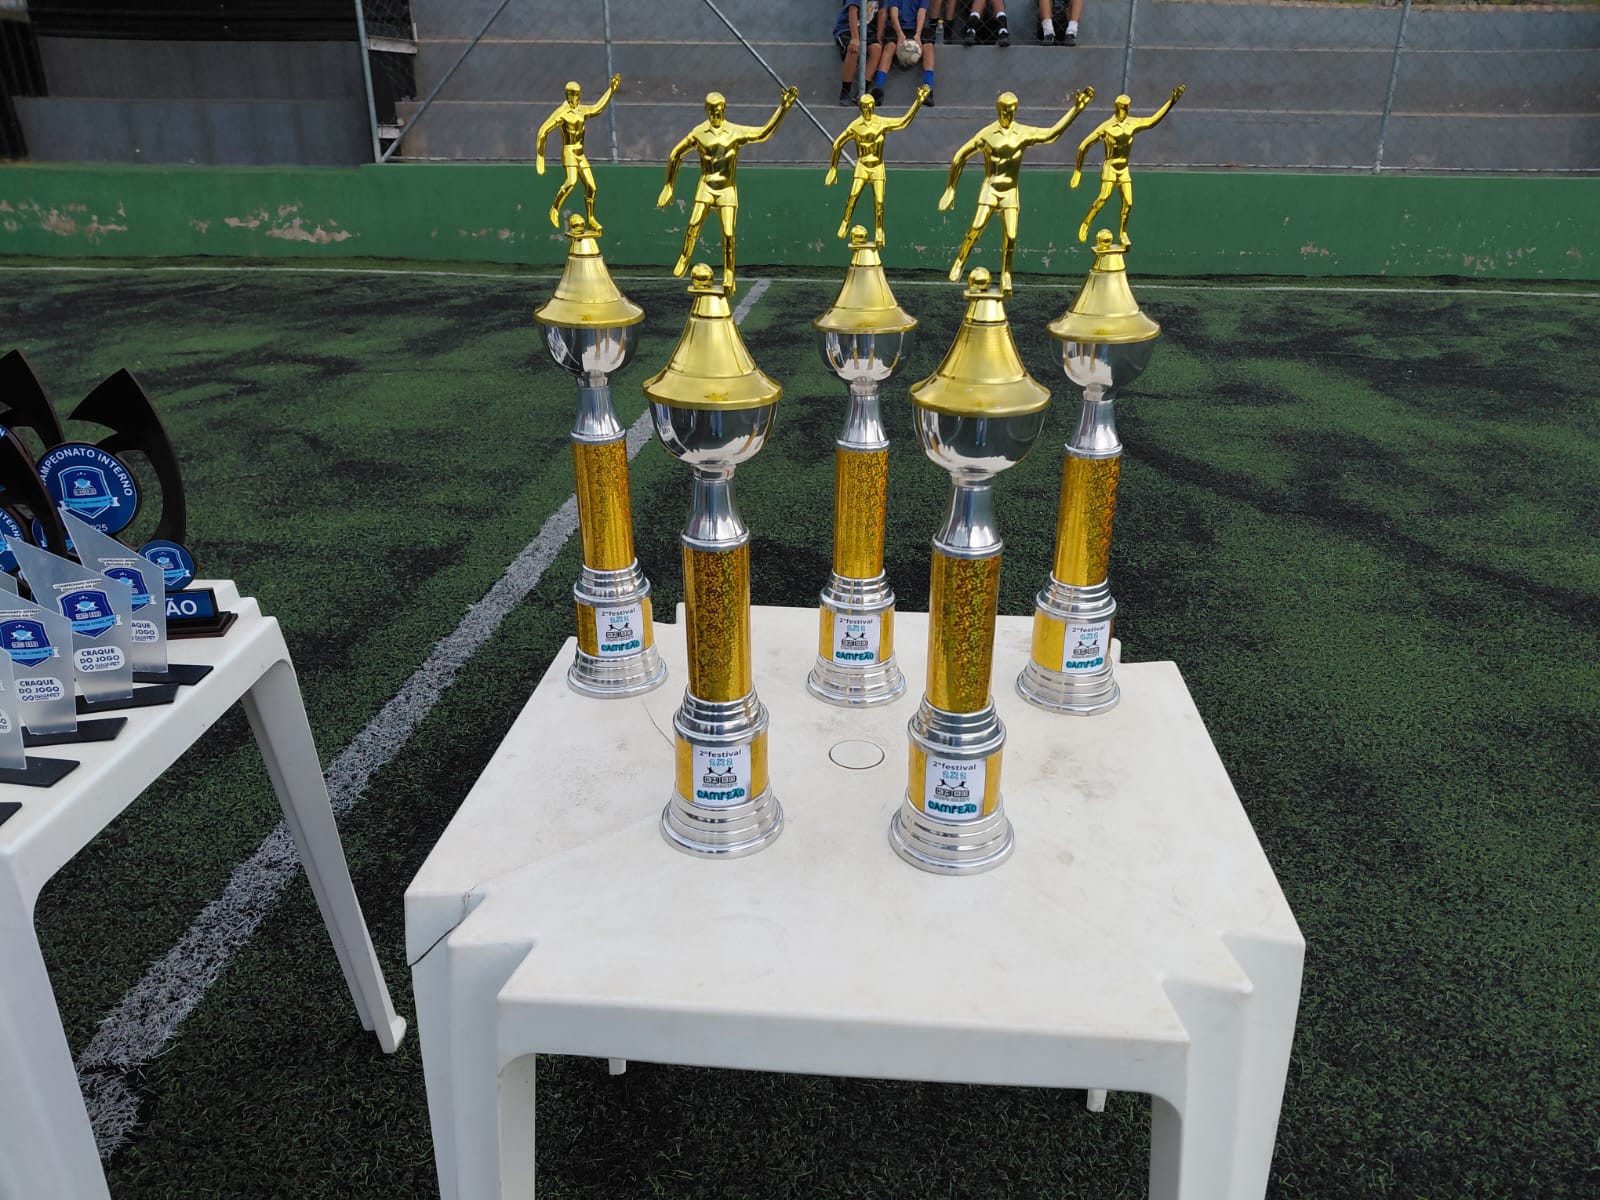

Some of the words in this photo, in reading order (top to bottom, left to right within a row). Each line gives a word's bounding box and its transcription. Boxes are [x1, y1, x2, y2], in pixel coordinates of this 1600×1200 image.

[40, 447, 95, 487] AMPEONATO
[97, 453, 133, 496] INTERNO
[166, 597, 198, 617] ÃO
[81, 648, 115, 657] CRAQUE
[95, 654, 120, 662] JOGO
[19, 679, 54, 687] CRAQUE
[35, 686, 60, 694] JOGO
